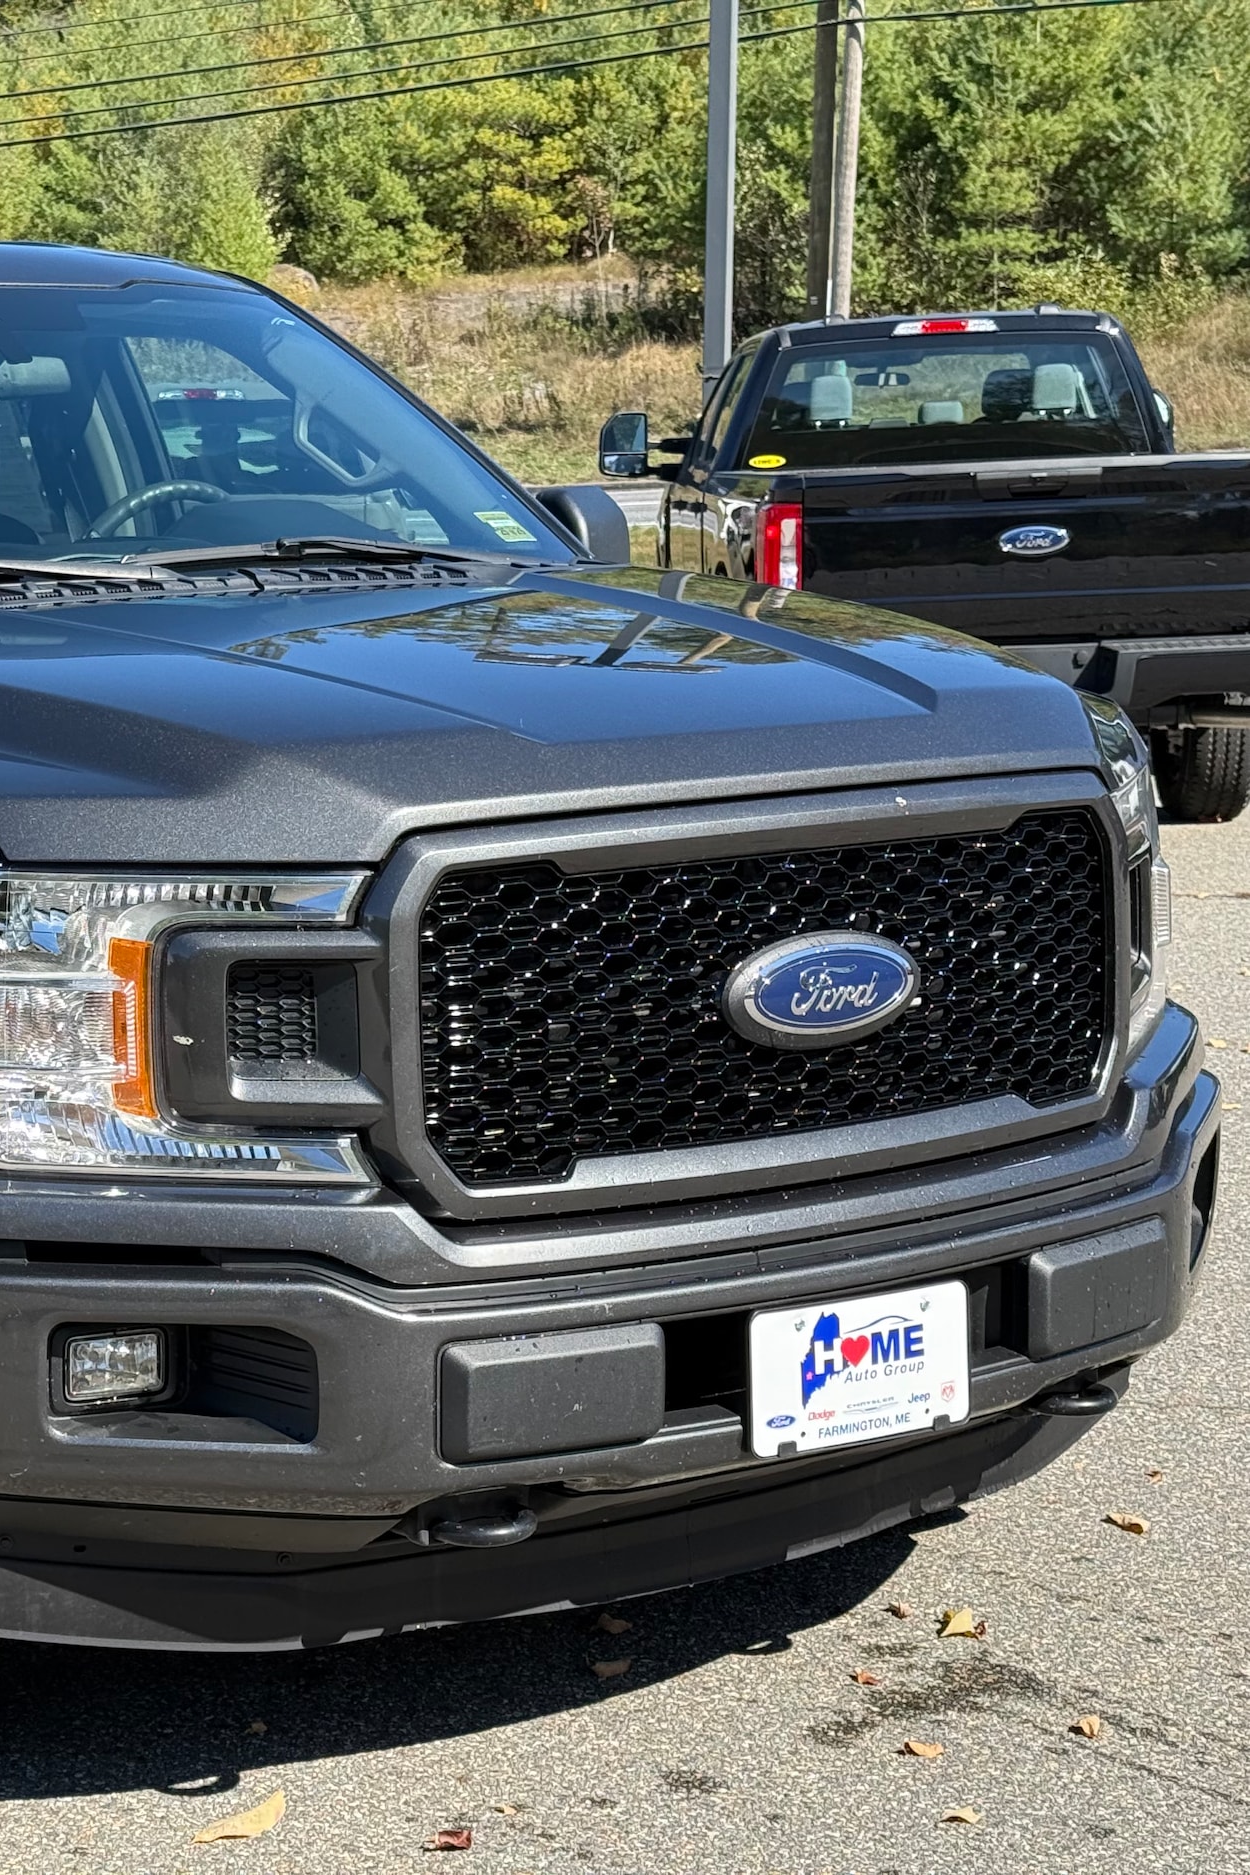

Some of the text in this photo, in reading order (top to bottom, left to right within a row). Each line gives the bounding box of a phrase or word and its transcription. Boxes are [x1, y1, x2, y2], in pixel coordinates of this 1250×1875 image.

[1015, 531, 1054, 548] Ford
[790, 963, 880, 1016] Ford
[844, 1360, 925, 1384] Auto Group
[907, 1392, 931, 1404] Jeep
[808, 1409, 836, 1421] Dodge
[818, 1412, 911, 1439] FARMINGTON, ME
